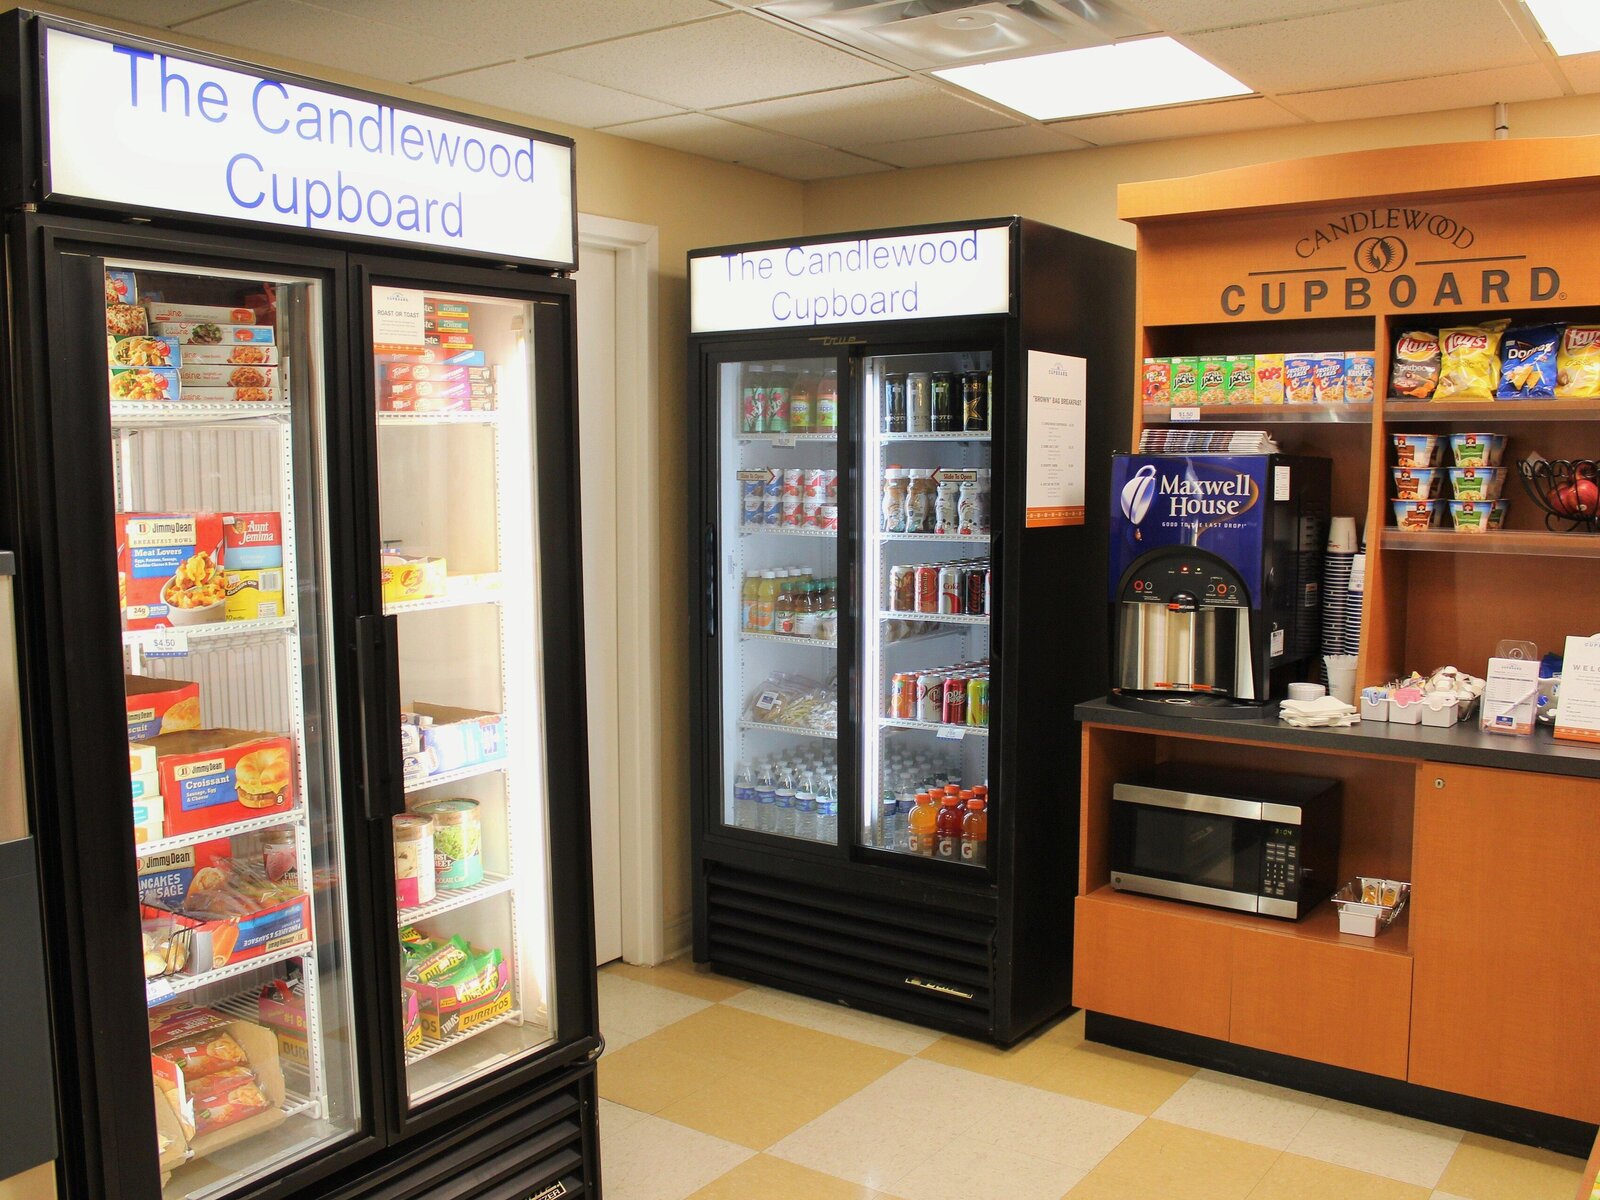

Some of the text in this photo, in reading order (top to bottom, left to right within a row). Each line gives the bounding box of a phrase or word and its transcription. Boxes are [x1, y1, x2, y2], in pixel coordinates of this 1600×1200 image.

[112, 44, 535, 184] The Candlewood
[226, 153, 464, 239] Cupboard
[1294, 208, 1475, 258] CANDLEWOOD
[720, 230, 978, 283] The Candlewood
[1220, 266, 1561, 316] CUPBOARD
[771, 281, 918, 325] Cupboard
[1159, 473, 1251, 496] Maxwell
[1169, 496, 1240, 517] House
[152, 522, 193, 534] Jimmy Dean
[248, 520, 269, 532] Aunt
[239, 530, 274, 545] Jemima
[134, 548, 182, 557] Meat Lovers
[153, 639, 176, 647] $4.50
[127, 711, 141, 721] immy
[127, 724, 149, 734] scuit
[192, 761, 223, 774] Jimmy Dean
[185, 775, 230, 790] Croissant
[939, 841, 952, 856] G
[961, 842, 973, 858] G
[146, 852, 191, 869] Jimmy Dean
[463, 997, 509, 1026] BURRITOS
[441, 1013, 460, 1034] TINA'S
